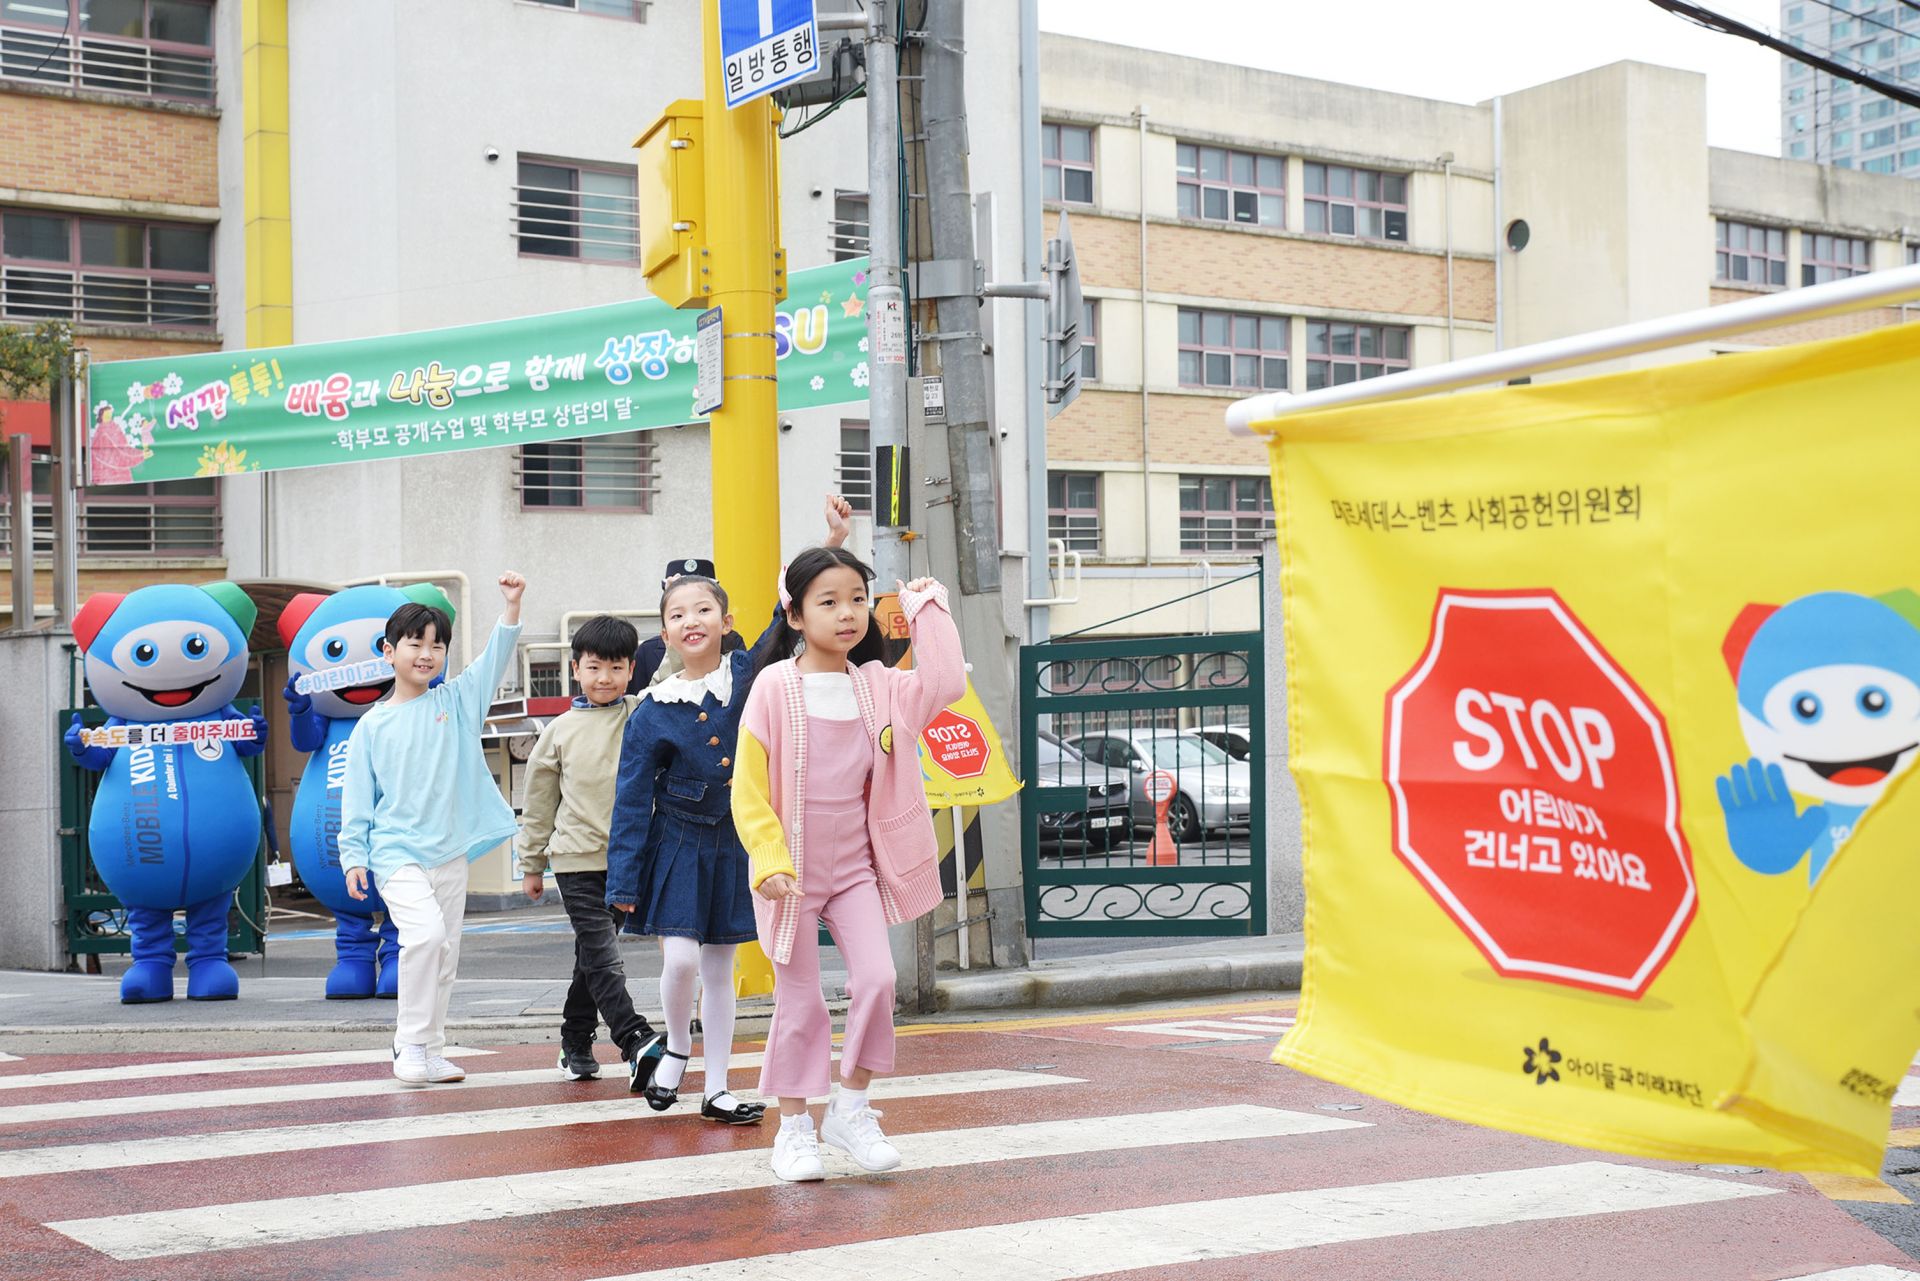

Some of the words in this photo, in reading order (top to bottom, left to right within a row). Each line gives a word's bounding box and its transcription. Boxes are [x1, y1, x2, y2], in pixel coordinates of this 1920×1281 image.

[727, 27, 813, 93] 일방통행
[887, 302, 897, 311] kt
[285, 373, 381, 421] 배움과
[388, 360, 511, 409] 나눔으로
[525, 353, 587, 391] 함께
[594, 329, 699, 385] 성장하
[775, 304, 829, 361] SU
[394, 417, 464, 446] 공개수업
[470, 414, 488, 437] 및
[493, 408, 548, 434] 학부모
[553, 399, 609, 428] 상담의
[1330, 497, 1458, 533] 메르세데스-벤츠
[1465, 484, 1641, 532] 사회공헌위원회
[298, 661, 395, 693] #어린이교통
[150, 727, 166, 742] 더
[172, 722, 257, 742] 줄여주세요
[1453, 687, 1616, 790] STOP
[129, 742, 157, 786] KID
[1499, 787, 1608, 841] 어린이가
[1464, 829, 1562, 875] 건너고
[1569, 840, 1652, 892] 있어요
